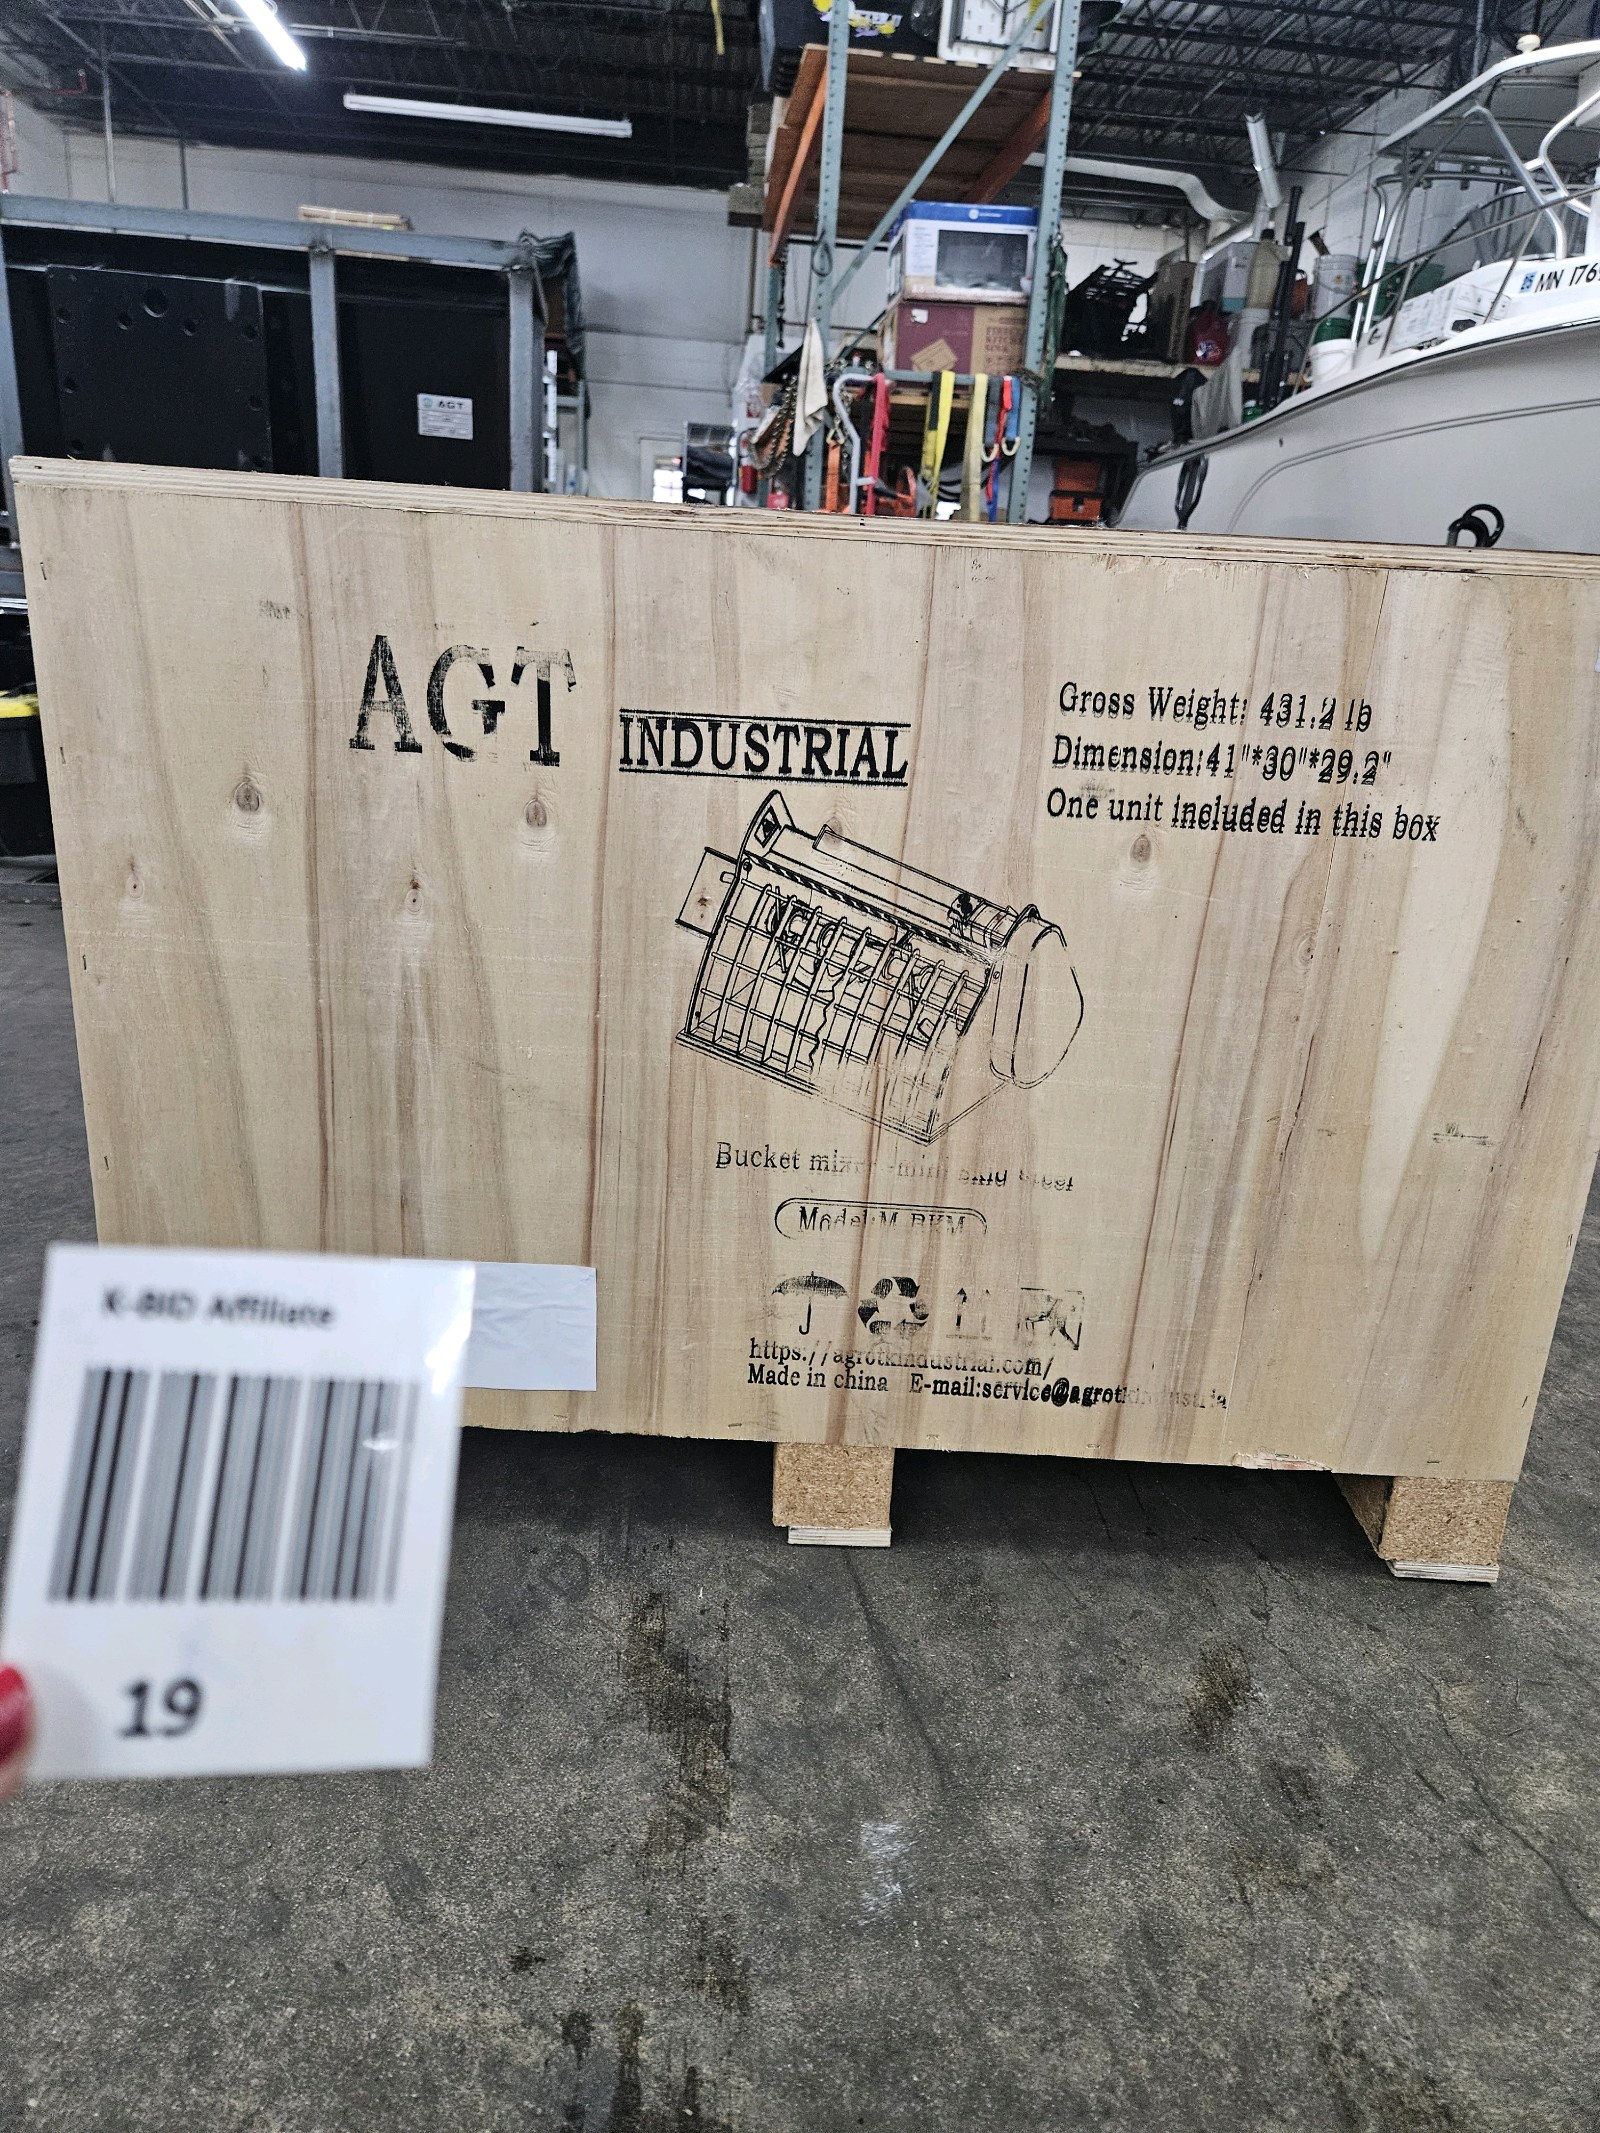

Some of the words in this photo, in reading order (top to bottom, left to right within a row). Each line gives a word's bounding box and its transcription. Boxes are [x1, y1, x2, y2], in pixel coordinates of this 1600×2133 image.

[1535, 270, 1564, 293] MN
[1569, 262, 1600, 287] 176
[349, 634, 577, 767] AGT
[1059, 681, 1136, 719] Gross
[1148, 685, 1248, 731] Weight:
[1259, 691, 1334, 731] 431.2
[1344, 698, 1373, 732] lb
[619, 715, 909, 780] INDUSTRIAL
[1047, 787, 1100, 821] One
[1108, 792, 1163, 822] unit
[1171, 794, 1288, 834] included
[1294, 800, 1322, 836] in
[1331, 801, 1383, 839] this
[1392, 804, 1441, 843] box
[715, 1141, 801, 1170] Bucket
[103, 1286, 198, 1320] K-BID
[206, 1291, 338, 1329] Affiliate
[747, 1363, 800, 1388] Made
[807, 1367, 827, 1389] in
[833, 1369, 890, 1392] china
[118, 1676, 204, 1740] 19
